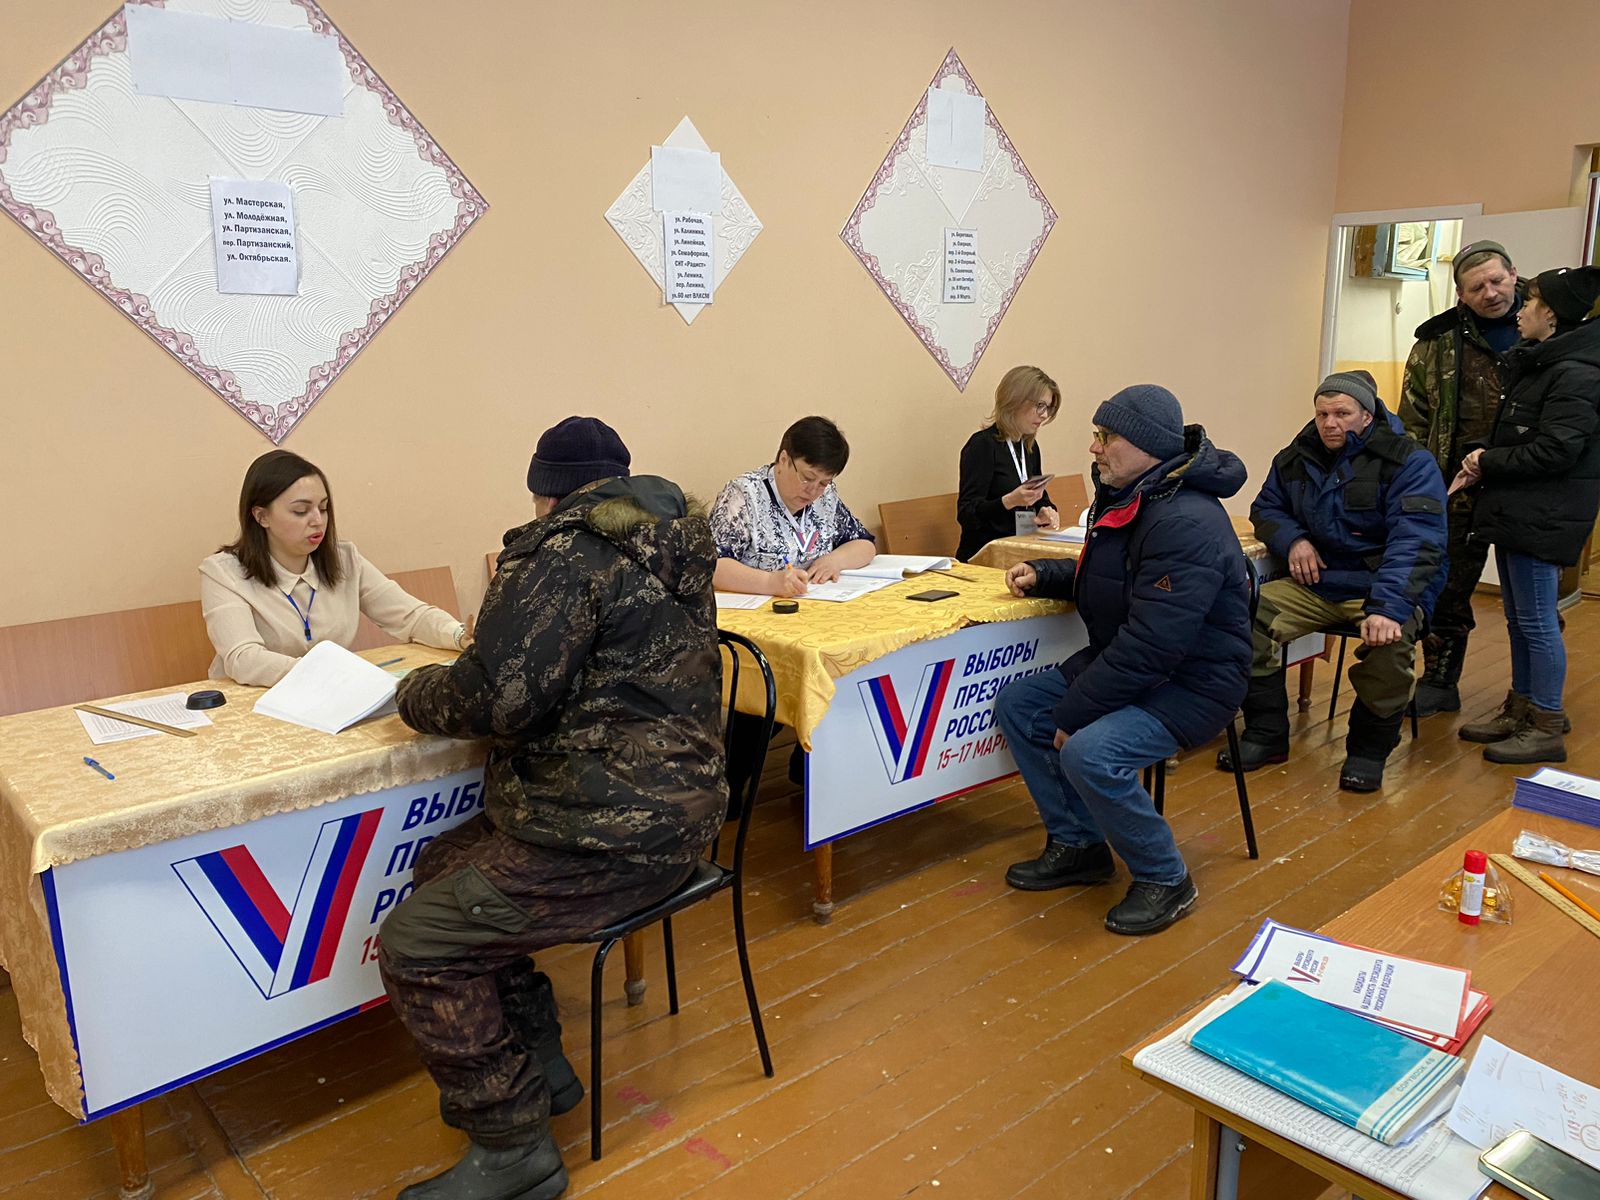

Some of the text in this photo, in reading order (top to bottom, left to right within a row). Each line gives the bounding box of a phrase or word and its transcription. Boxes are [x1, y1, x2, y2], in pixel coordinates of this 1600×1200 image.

[236, 197, 285, 209] Мастерская,
[236, 212, 287, 223] Молодёжная,
[234, 224, 291, 236] Партизанская,
[236, 239, 293, 250] Партизанский,
[239, 253, 291, 263] Октябрьская.
[963, 638, 1040, 678] ВЫБОРЫ
[944, 708, 999, 742] РОССИ
[972, 734, 1008, 759] МАРТ
[401, 781, 485, 831] ВЫБ
